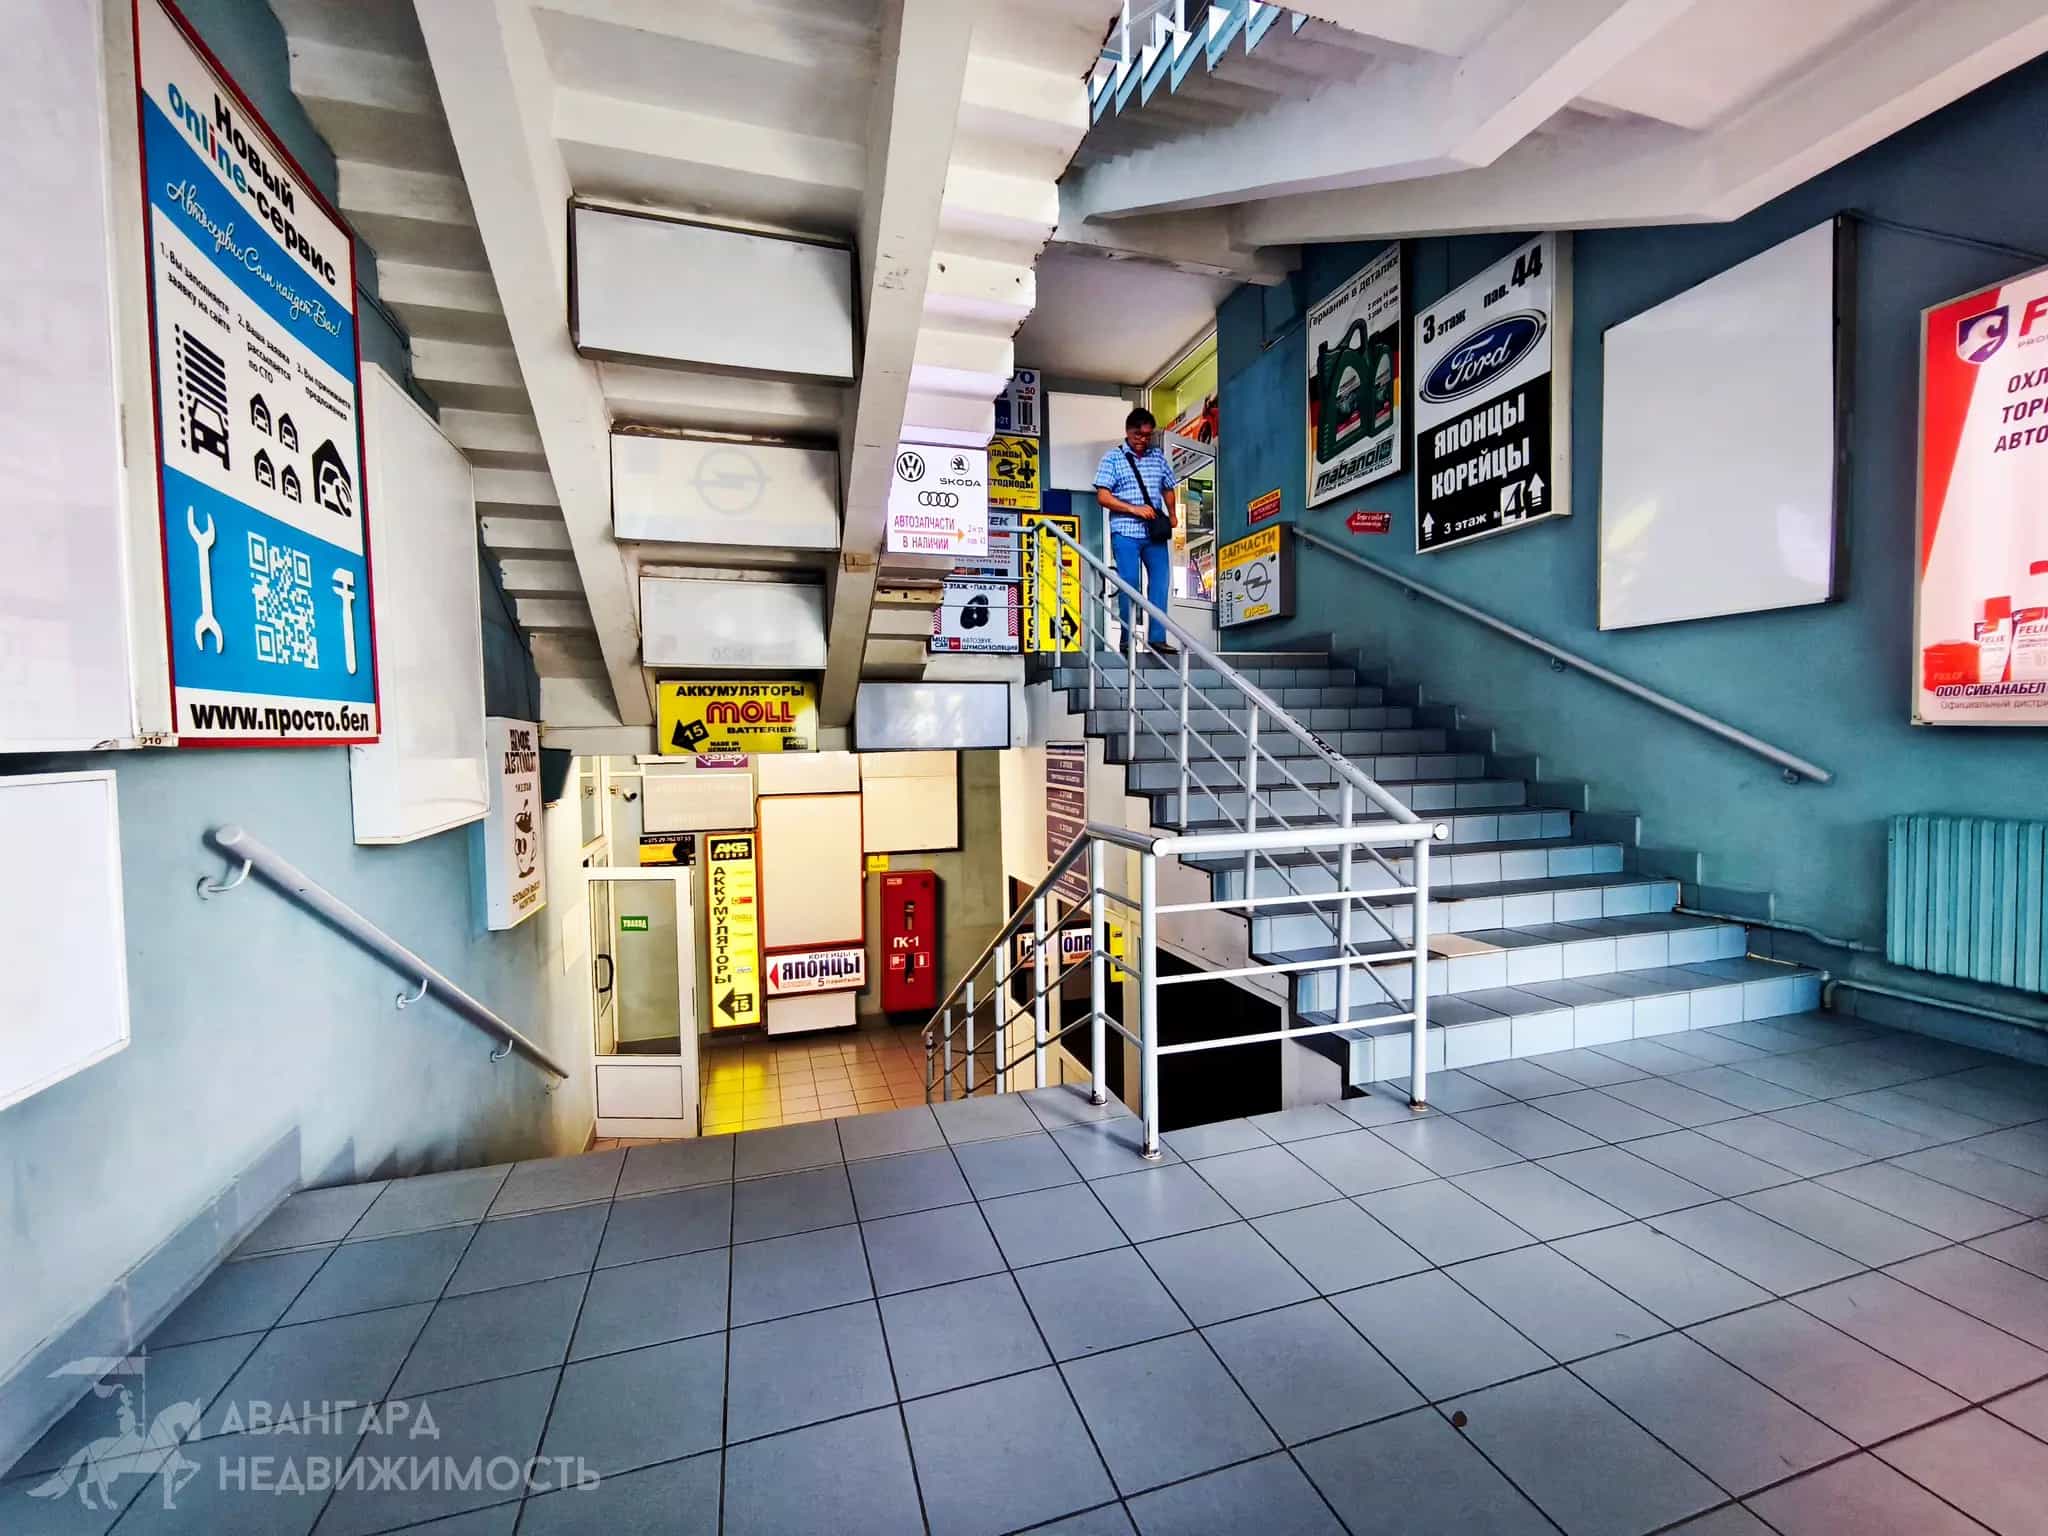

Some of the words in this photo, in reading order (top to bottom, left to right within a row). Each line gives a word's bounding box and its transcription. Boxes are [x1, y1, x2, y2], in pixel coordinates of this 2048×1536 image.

[215, 93, 294, 216] Новый
[166, 180, 244, 262] Автосервис
[244, 248, 275, 287] Сам
[310, 299, 342, 337] Вас!
[1423, 314, 1435, 344] 3
[1437, 308, 1466, 336] этаж
[1483, 285, 1509, 309] пав.
[1511, 245, 1543, 288] 44
[1444, 333, 1512, 392] Ford
[1434, 392, 1525, 459] ЯПОНЦЫ
[1431, 437, 1530, 501] КОРЕЙЦЫ
[894, 515, 955, 531] АВТОЗАПЧАСТИ
[1444, 523, 1451, 535] 3
[1455, 513, 1487, 531] этаж
[902, 536, 908, 548] В
[912, 536, 949, 550] НАЛИЧИИ
[1222, 530, 1275, 561] ЗАПЧАСТИ
[676, 686, 804, 697] АККУМУЛЯТОРЫ
[190, 703, 369, 736] www.просто.бел
[706, 701, 796, 724] MOLL
[684, 725, 704, 740] 15
[727, 726, 797, 734] BATTERIEN
[893, 935, 919, 948] ПК-1
[782, 956, 860, 980] ЯПОНЦЫ
